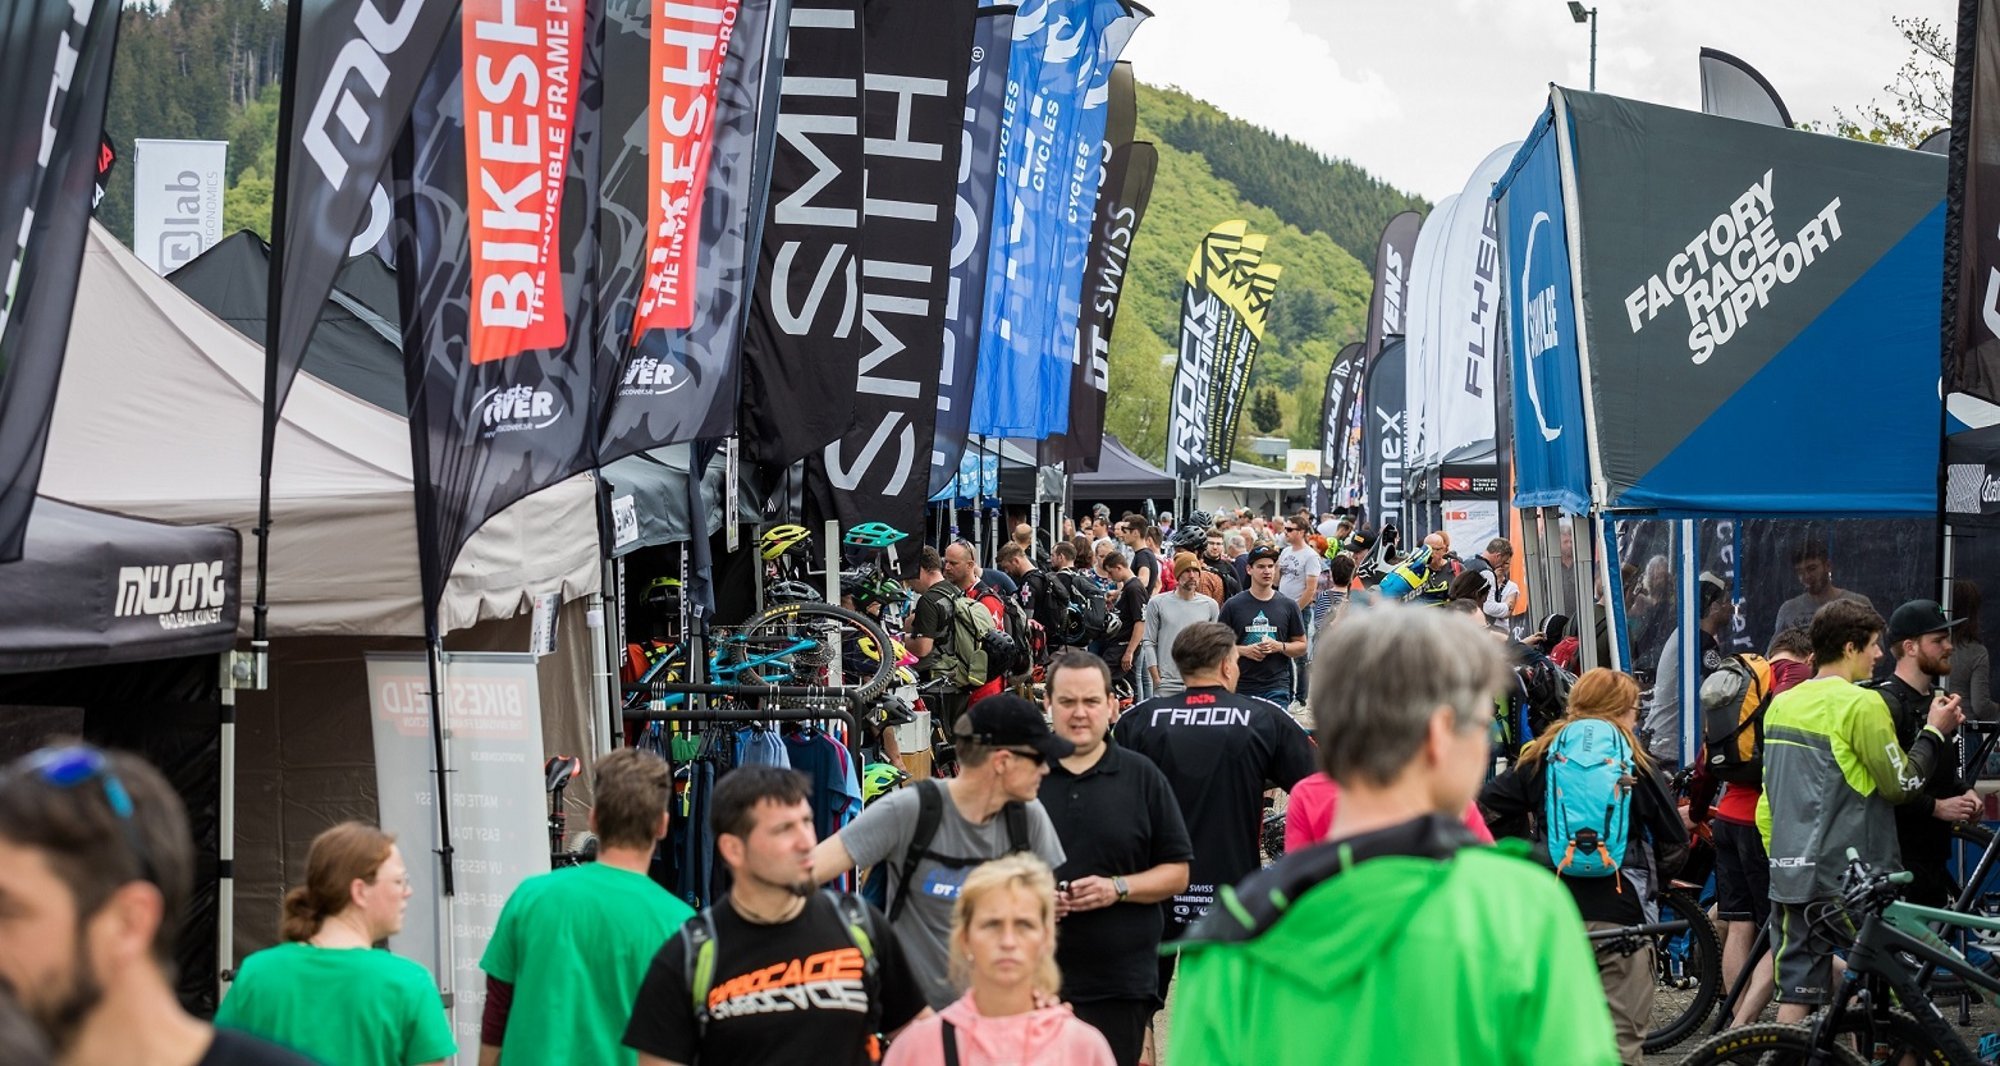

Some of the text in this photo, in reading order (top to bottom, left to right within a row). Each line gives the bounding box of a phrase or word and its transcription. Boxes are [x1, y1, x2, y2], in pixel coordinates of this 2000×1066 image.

[546, 19, 569, 122] FRAME
[996, 80, 1020, 178] CYCLES
[1033, 99, 1059, 192] CYCLES
[1067, 140, 1091, 224] CYCLES
[825, 73, 948, 496] SMITH
[1092, 202, 1137, 318] SWISS
[1381, 243, 1403, 336] VENS
[1625, 168, 1774, 333] FACTORY
[1683, 218, 1781, 326] RACE
[1687, 196, 1842, 365] SUPPORT
[620, 364, 675, 386] VER
[1174, 286, 1207, 465] ROCK
[1193, 293, 1221, 463] MACHINE
[764, 604, 801, 618] MAXXIS
[1151, 707, 1251, 727] RADON
[1189, 884, 1214, 893] SWISS
[1715, 1035, 1778, 1055] MAXXIS
